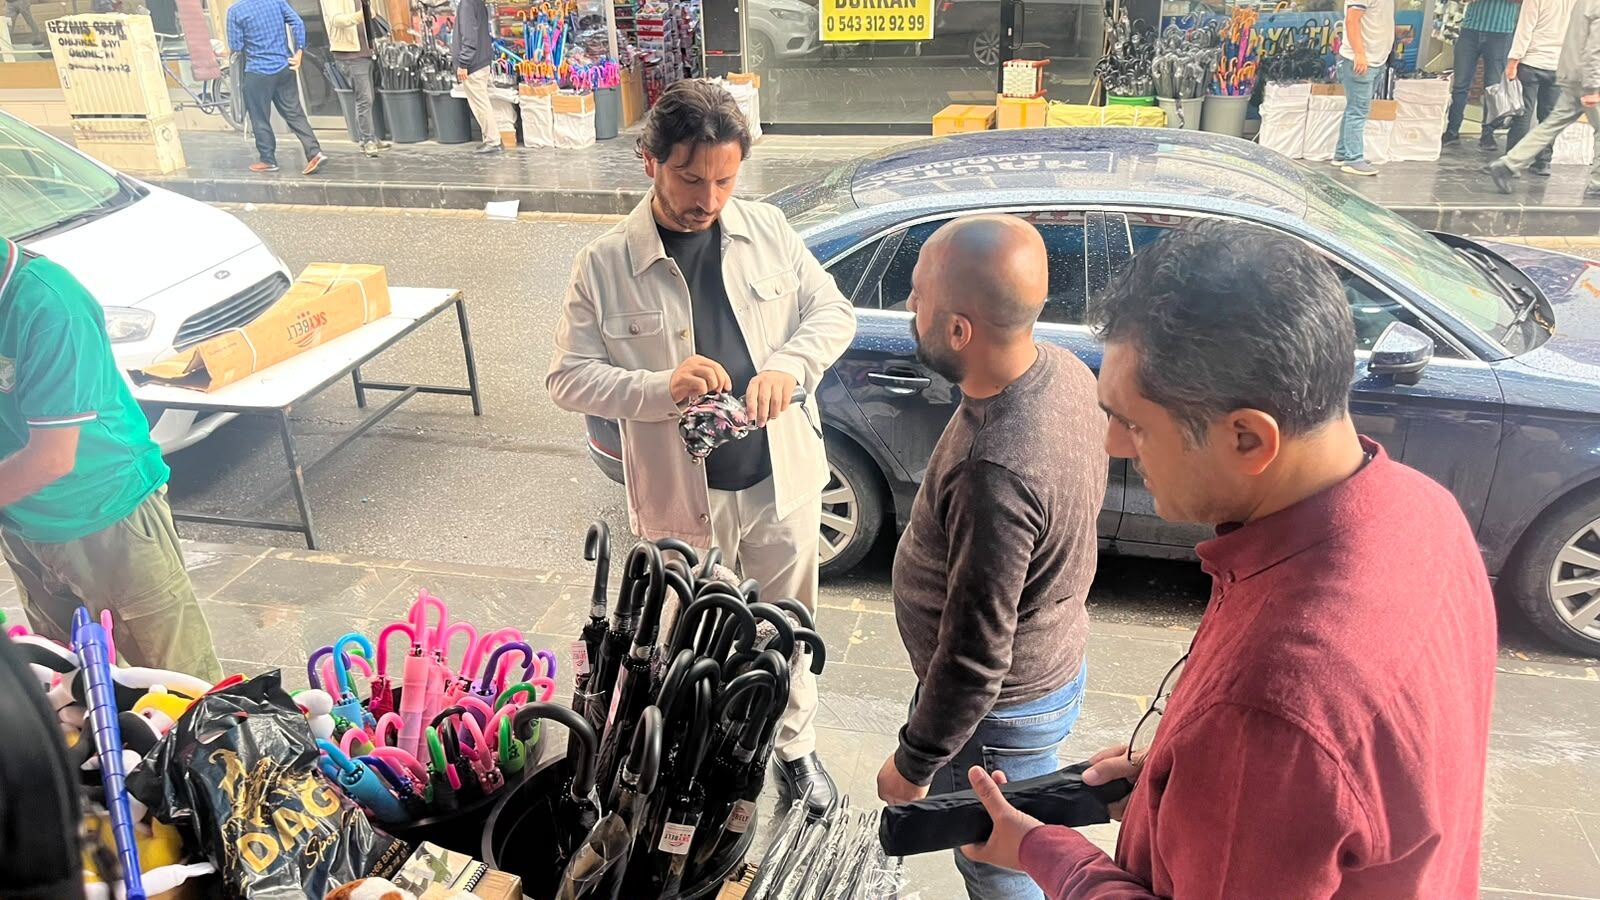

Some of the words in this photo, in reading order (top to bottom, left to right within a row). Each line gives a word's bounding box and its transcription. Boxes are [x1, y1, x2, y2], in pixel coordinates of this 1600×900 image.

[826, 16, 835, 32] 0
[839, 15, 862, 31] 543
[866, 15, 886, 31] 312
[889, 15, 904, 31] 92
[908, 15, 925, 31] 99
[287, 311, 327, 340] SKYBELT
